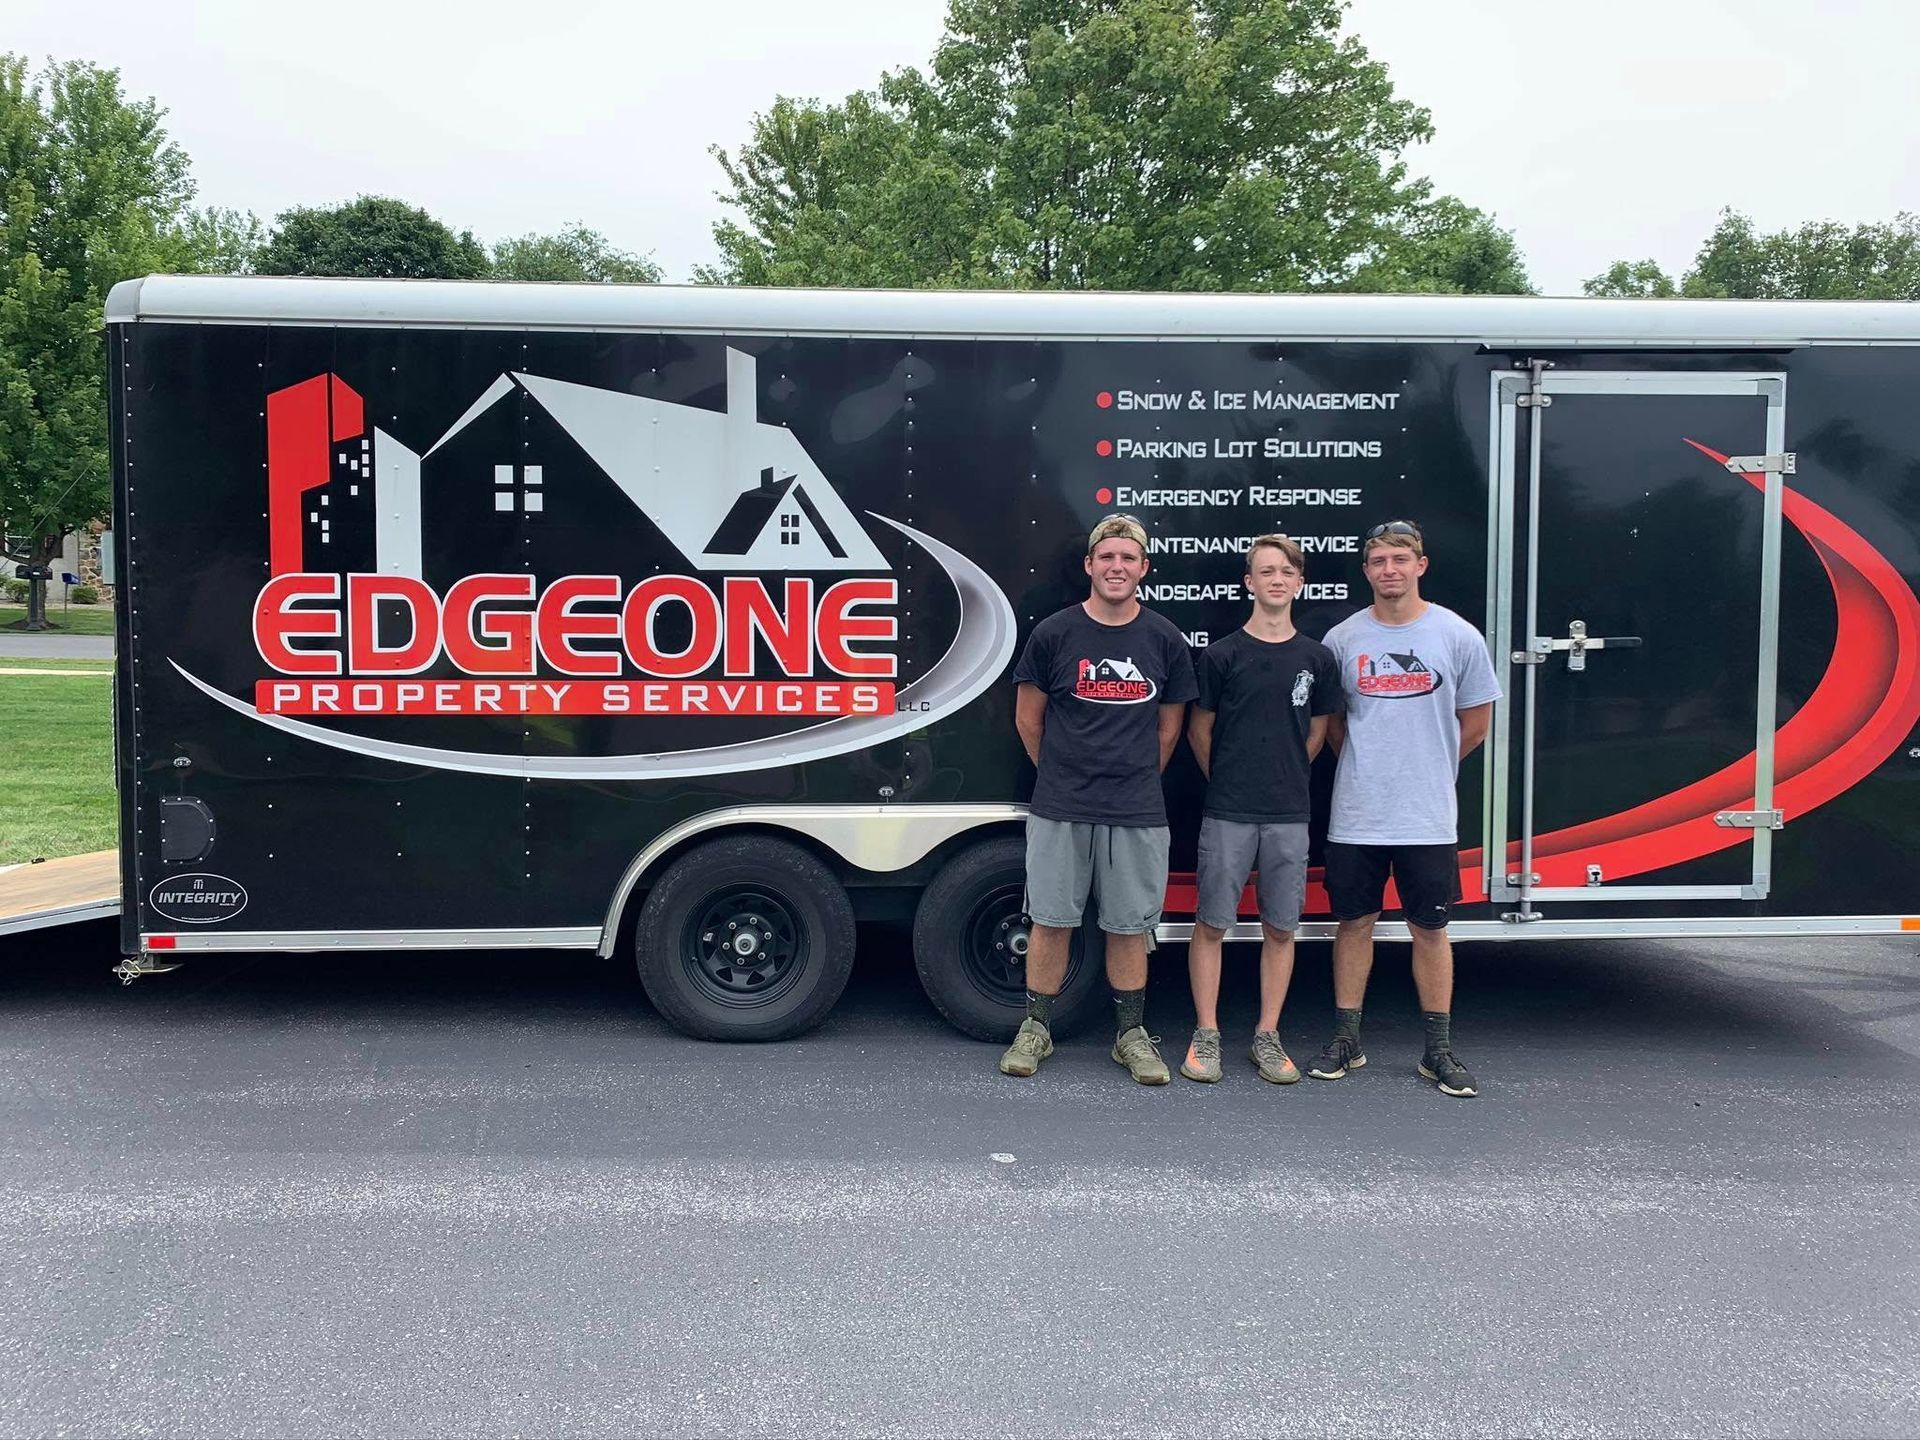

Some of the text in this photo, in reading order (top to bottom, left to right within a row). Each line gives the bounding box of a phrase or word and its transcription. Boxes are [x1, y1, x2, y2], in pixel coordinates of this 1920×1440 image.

[1188, 391, 1206, 410] &
[1146, 537, 1260, 553] INTENANC
[1135, 585, 1241, 601] ANDSCAPE
[252, 572, 898, 679] EDGEONE
[1076, 680, 1148, 694] EDGEONE
[273, 684, 930, 712] PROPERTY SERVICES LLC
[158, 892, 242, 903] INTEGRITY
